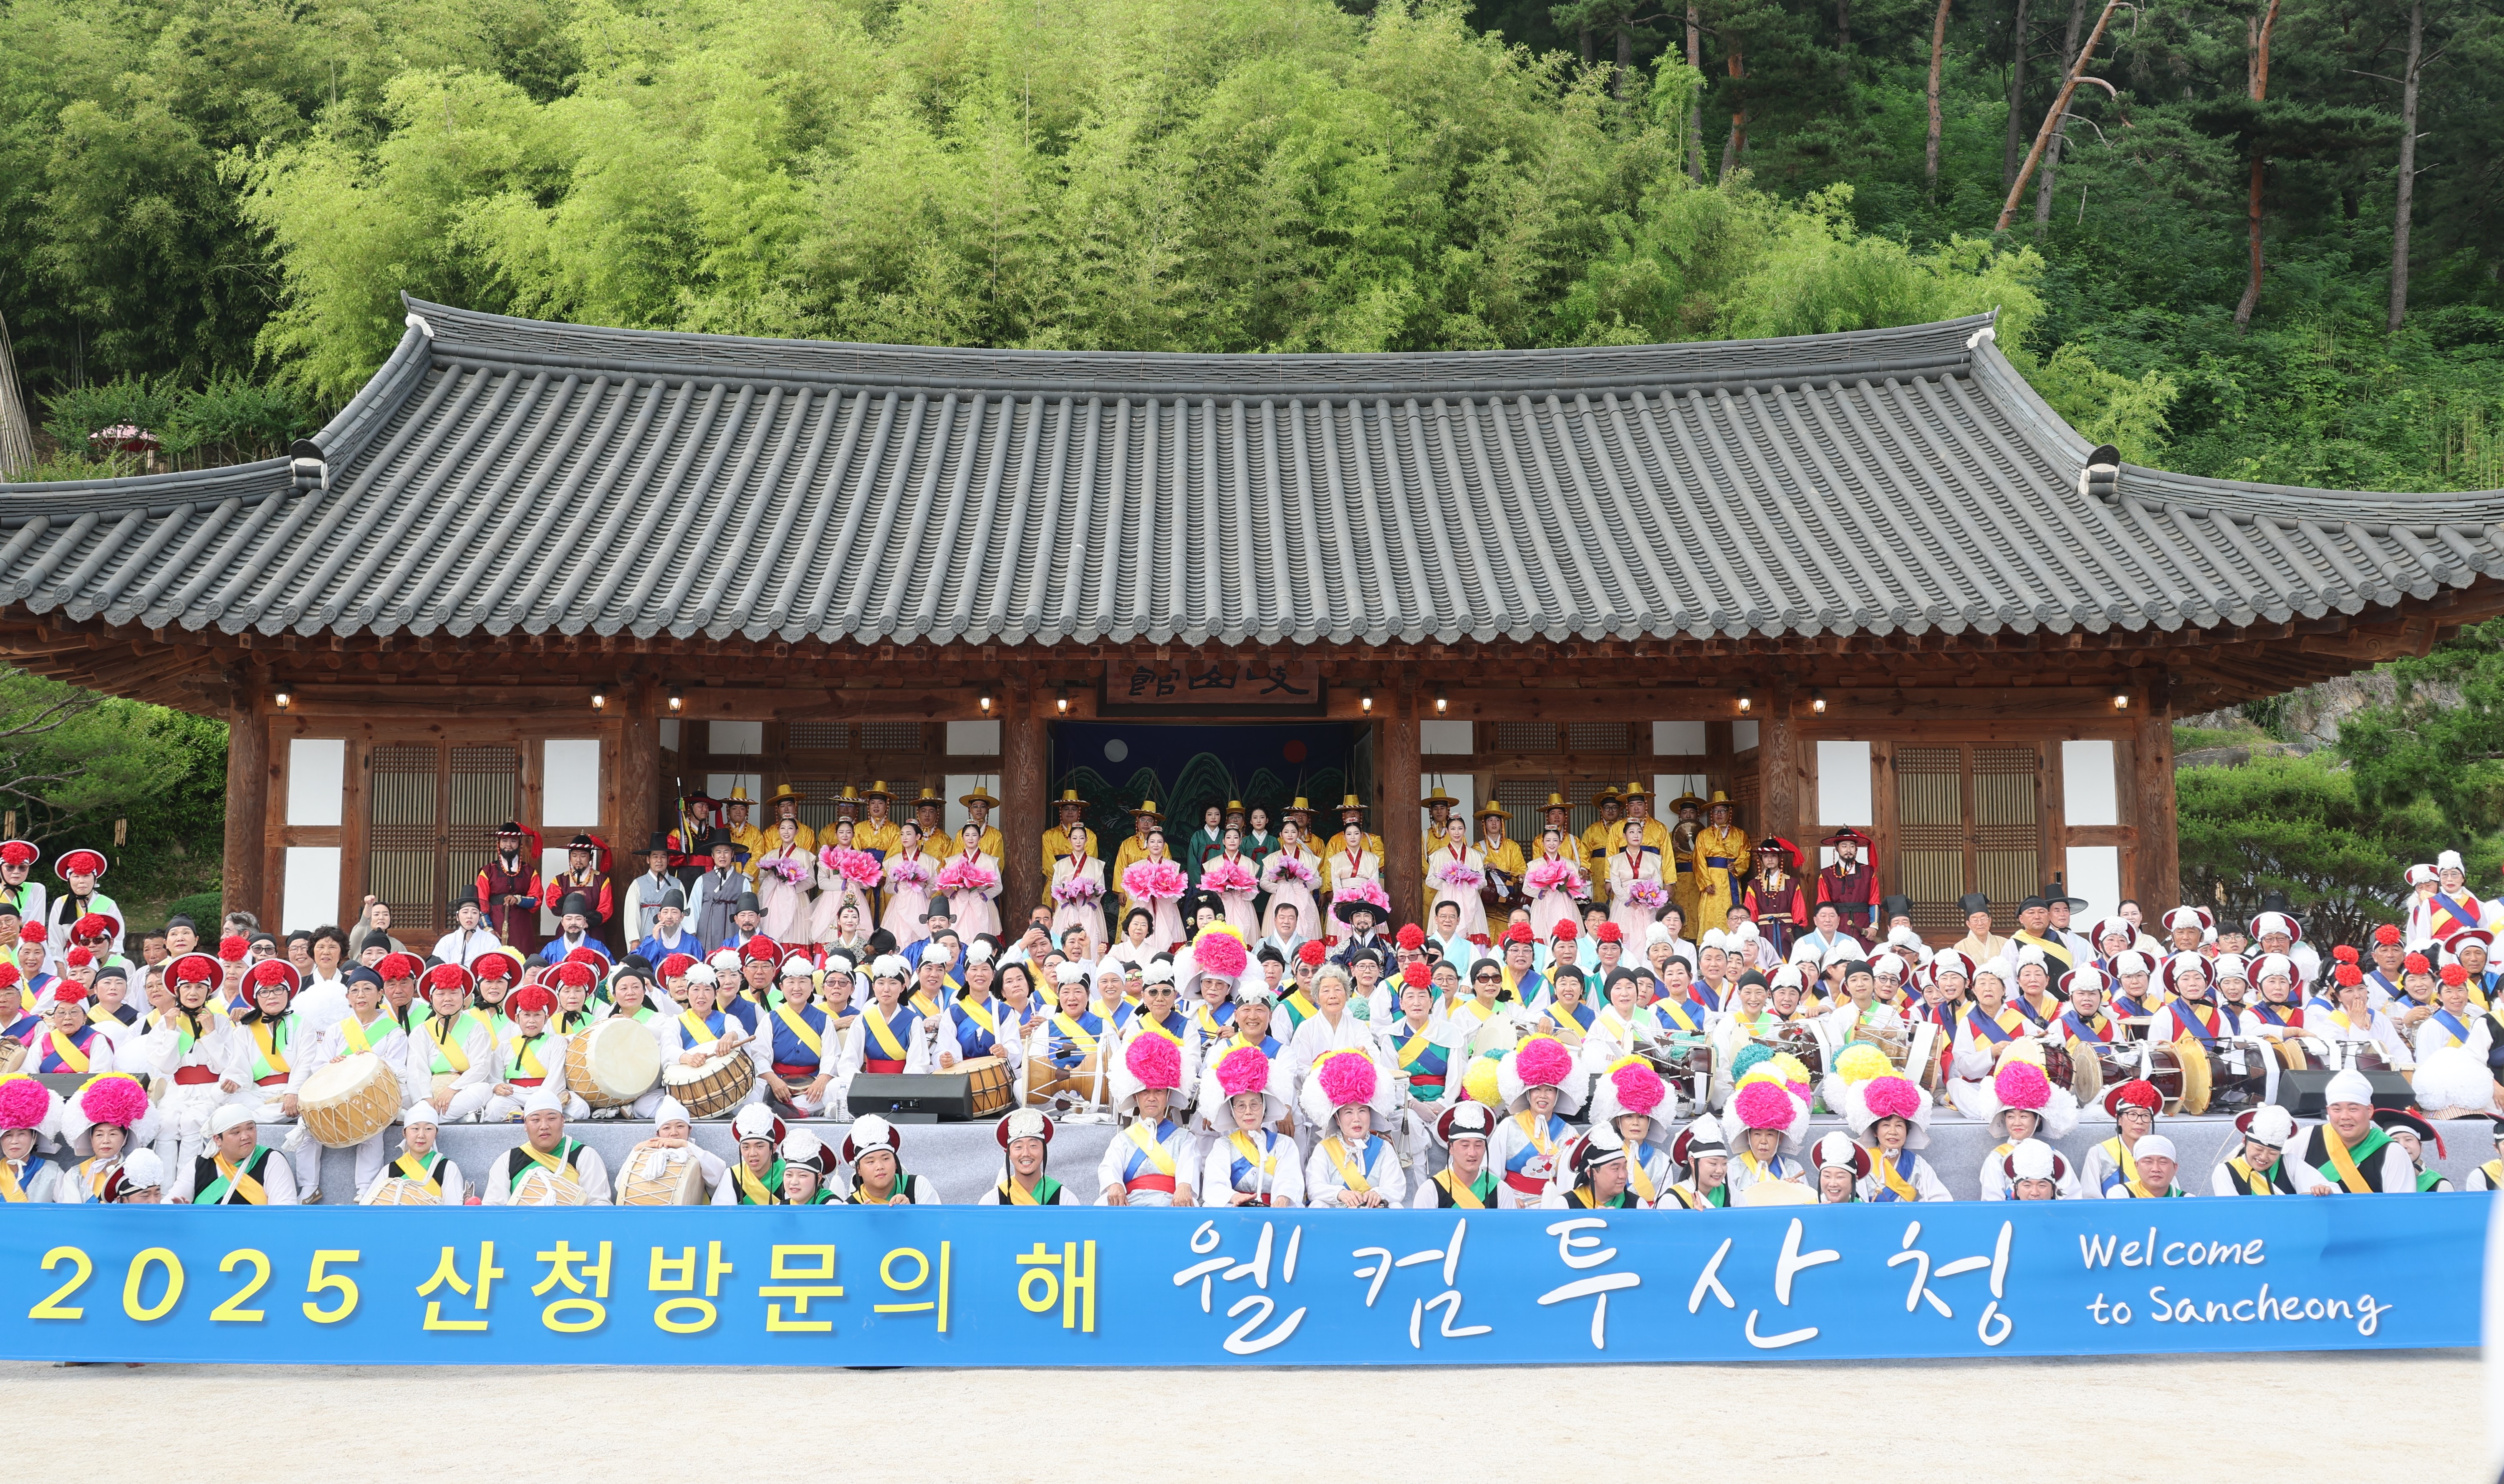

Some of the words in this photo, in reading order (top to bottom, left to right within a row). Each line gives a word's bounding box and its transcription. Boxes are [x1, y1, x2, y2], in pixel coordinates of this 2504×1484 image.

[2079, 1227, 2265, 1269] Welcome
[28, 1247, 360, 1323] 2025
[416, 1241, 950, 1333] 산청방문의
[1016, 1240, 1096, 1332] 해
[2087, 1293, 2132, 1325] to
[2150, 1284, 2393, 1336] Sancheong
